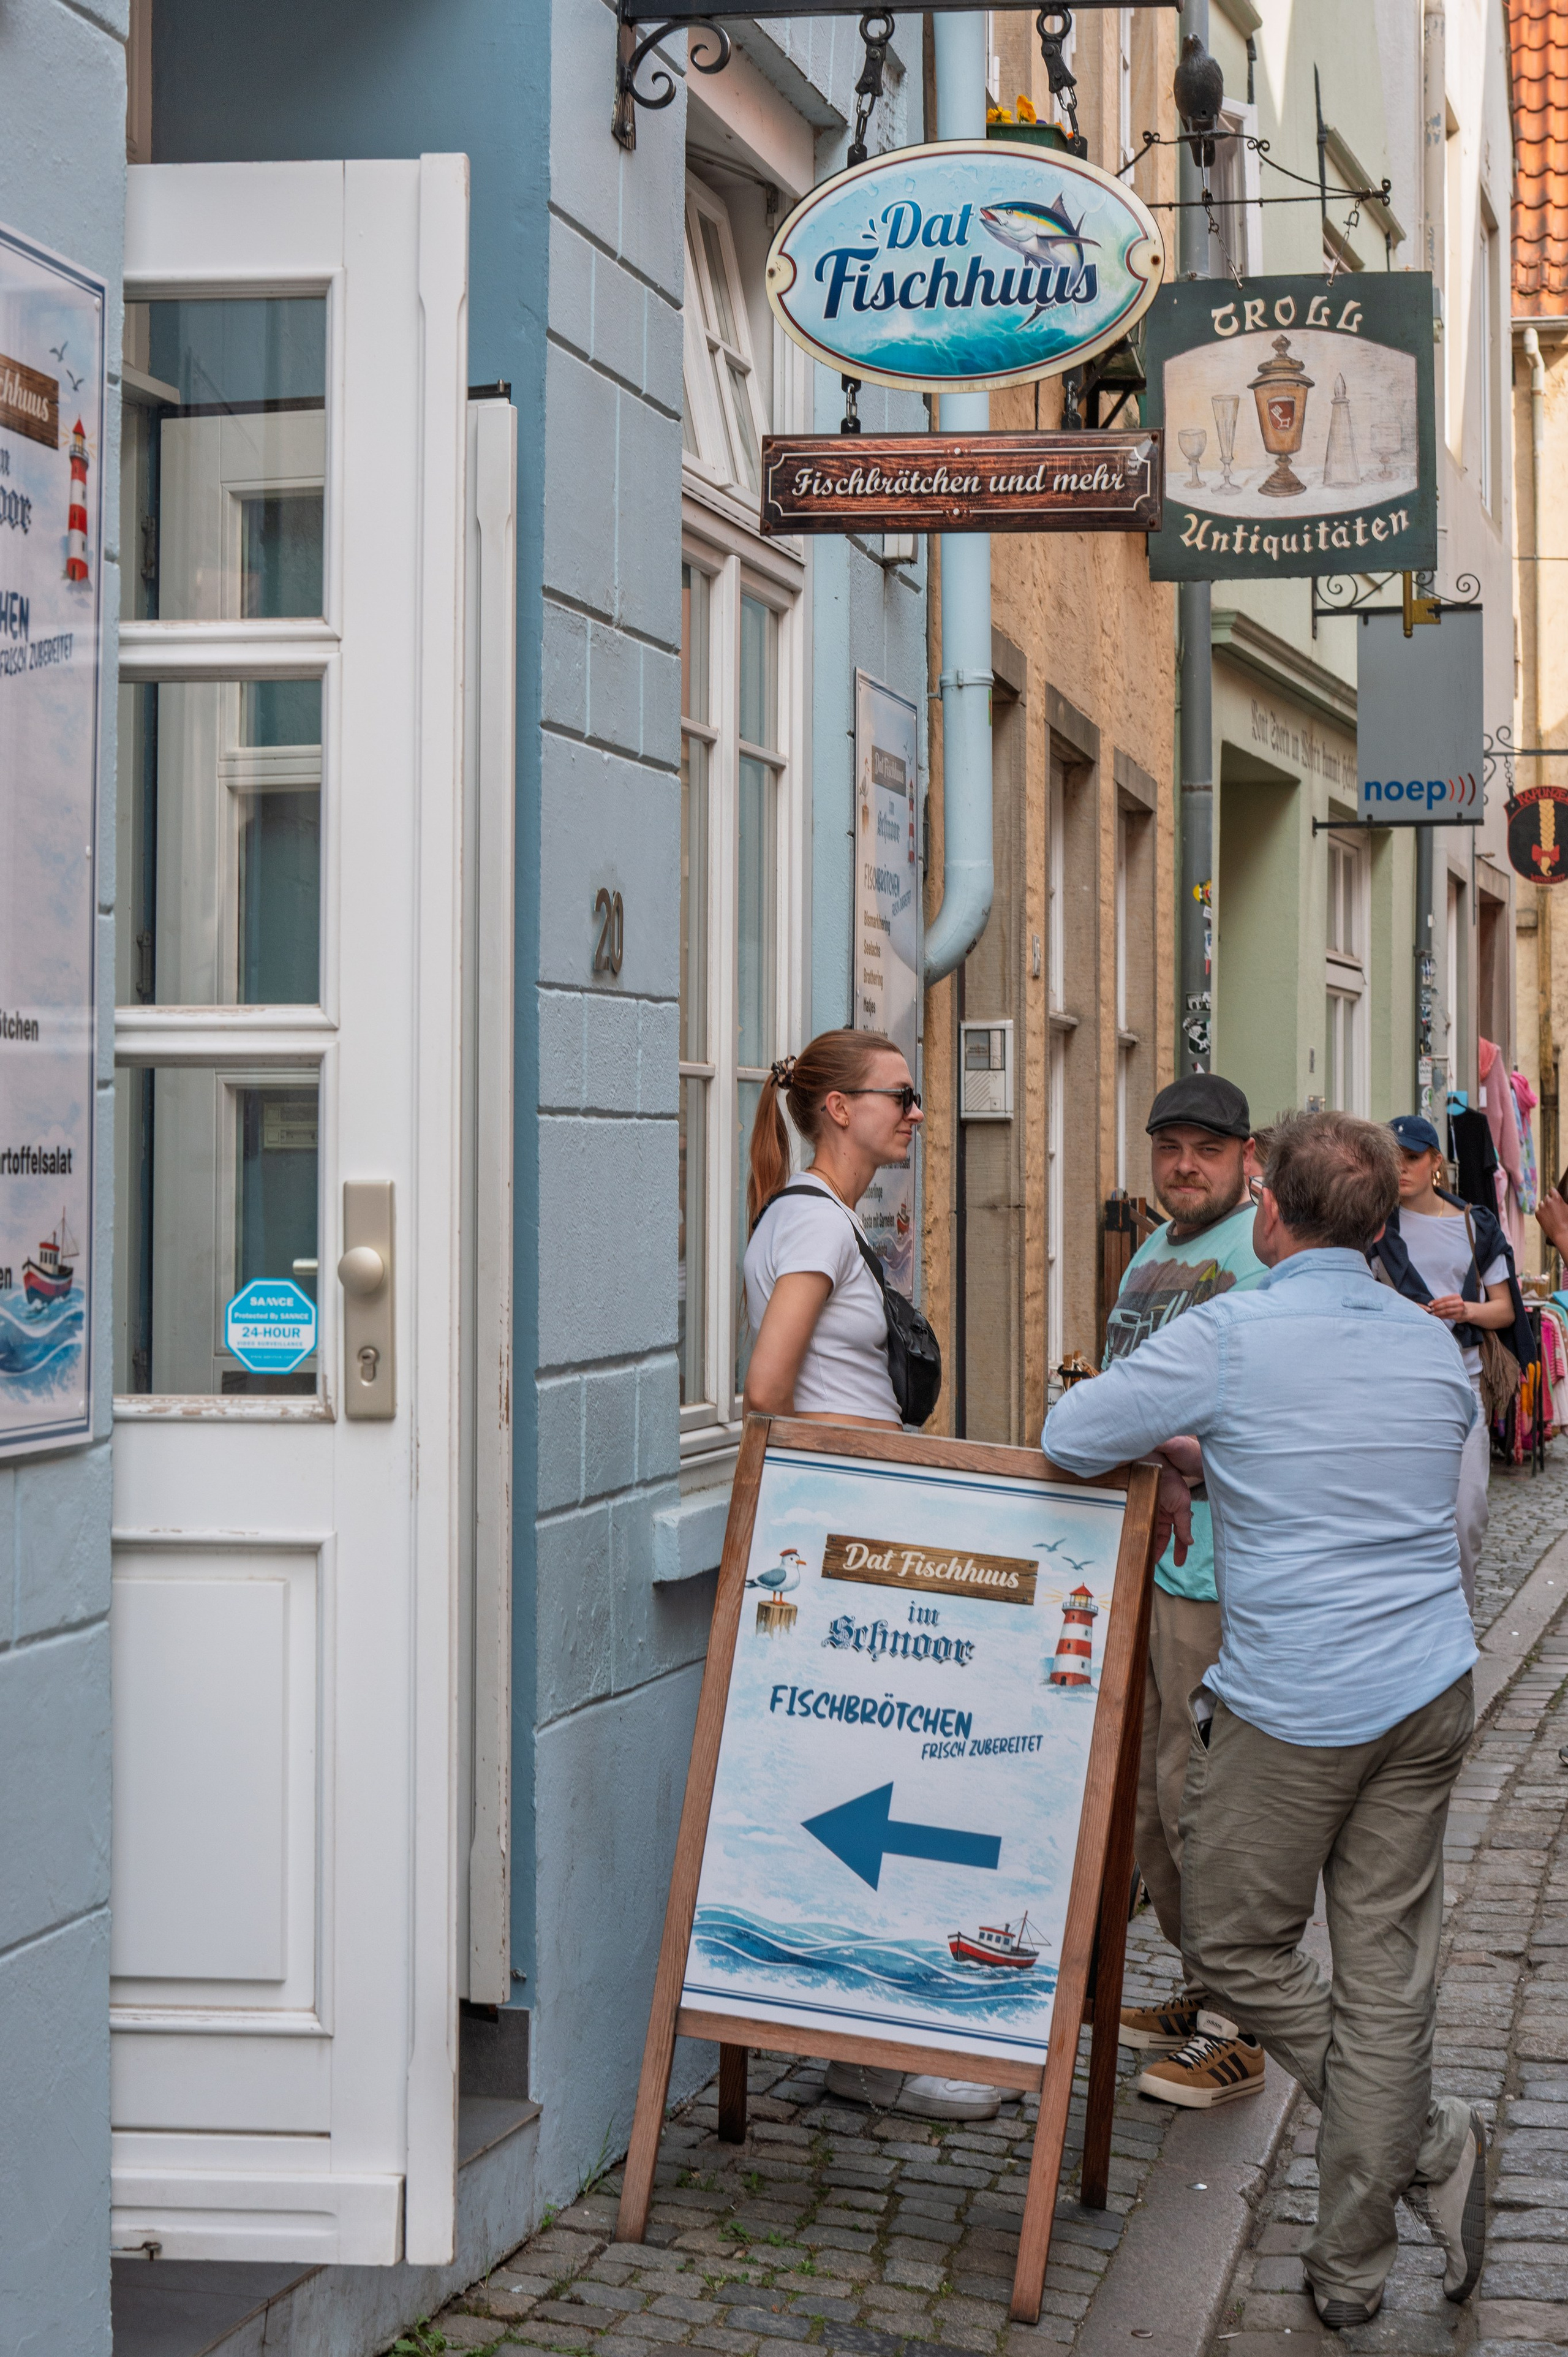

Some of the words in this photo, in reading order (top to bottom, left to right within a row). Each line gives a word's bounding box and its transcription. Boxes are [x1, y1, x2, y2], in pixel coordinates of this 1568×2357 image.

[881, 200, 974, 249] Dat
[814, 246, 1098, 320] Fischhuus
[1211, 295, 1363, 337] TROLL
[791, 465, 981, 497] Fischbrötchen
[989, 464, 1045, 492] und
[1053, 463, 1125, 491] mehr
[1179, 509, 1410, 561] Antiquitäten
[29, 632, 74, 670] ZUBEREITET
[1364, 779, 1447, 811] noep
[1516, 786, 1568, 806] RAPUNZE
[864, 863, 900, 898] FISCHBRÖTCHEN
[594, 887, 624, 974] 20
[863, 938, 881, 958] Seelachs
[863, 967, 883, 991] Brathering
[863, 996, 876, 1018] Matjes
[879, 1212, 895, 1228] Garnelen
[242, 1326, 301, 1338] 24-HOUR
[843, 1542, 894, 1573] Dat
[899, 1549, 1020, 1590] Fischhuus
[908, 1600, 941, 1627] im
[821, 1614, 975, 1667] Schnoor
[769, 1684, 973, 1739] FISCHBRÖTCHEN
[921, 1739, 966, 1760] FRISCH
[968, 1734, 1044, 1757] ZUBEREITET
